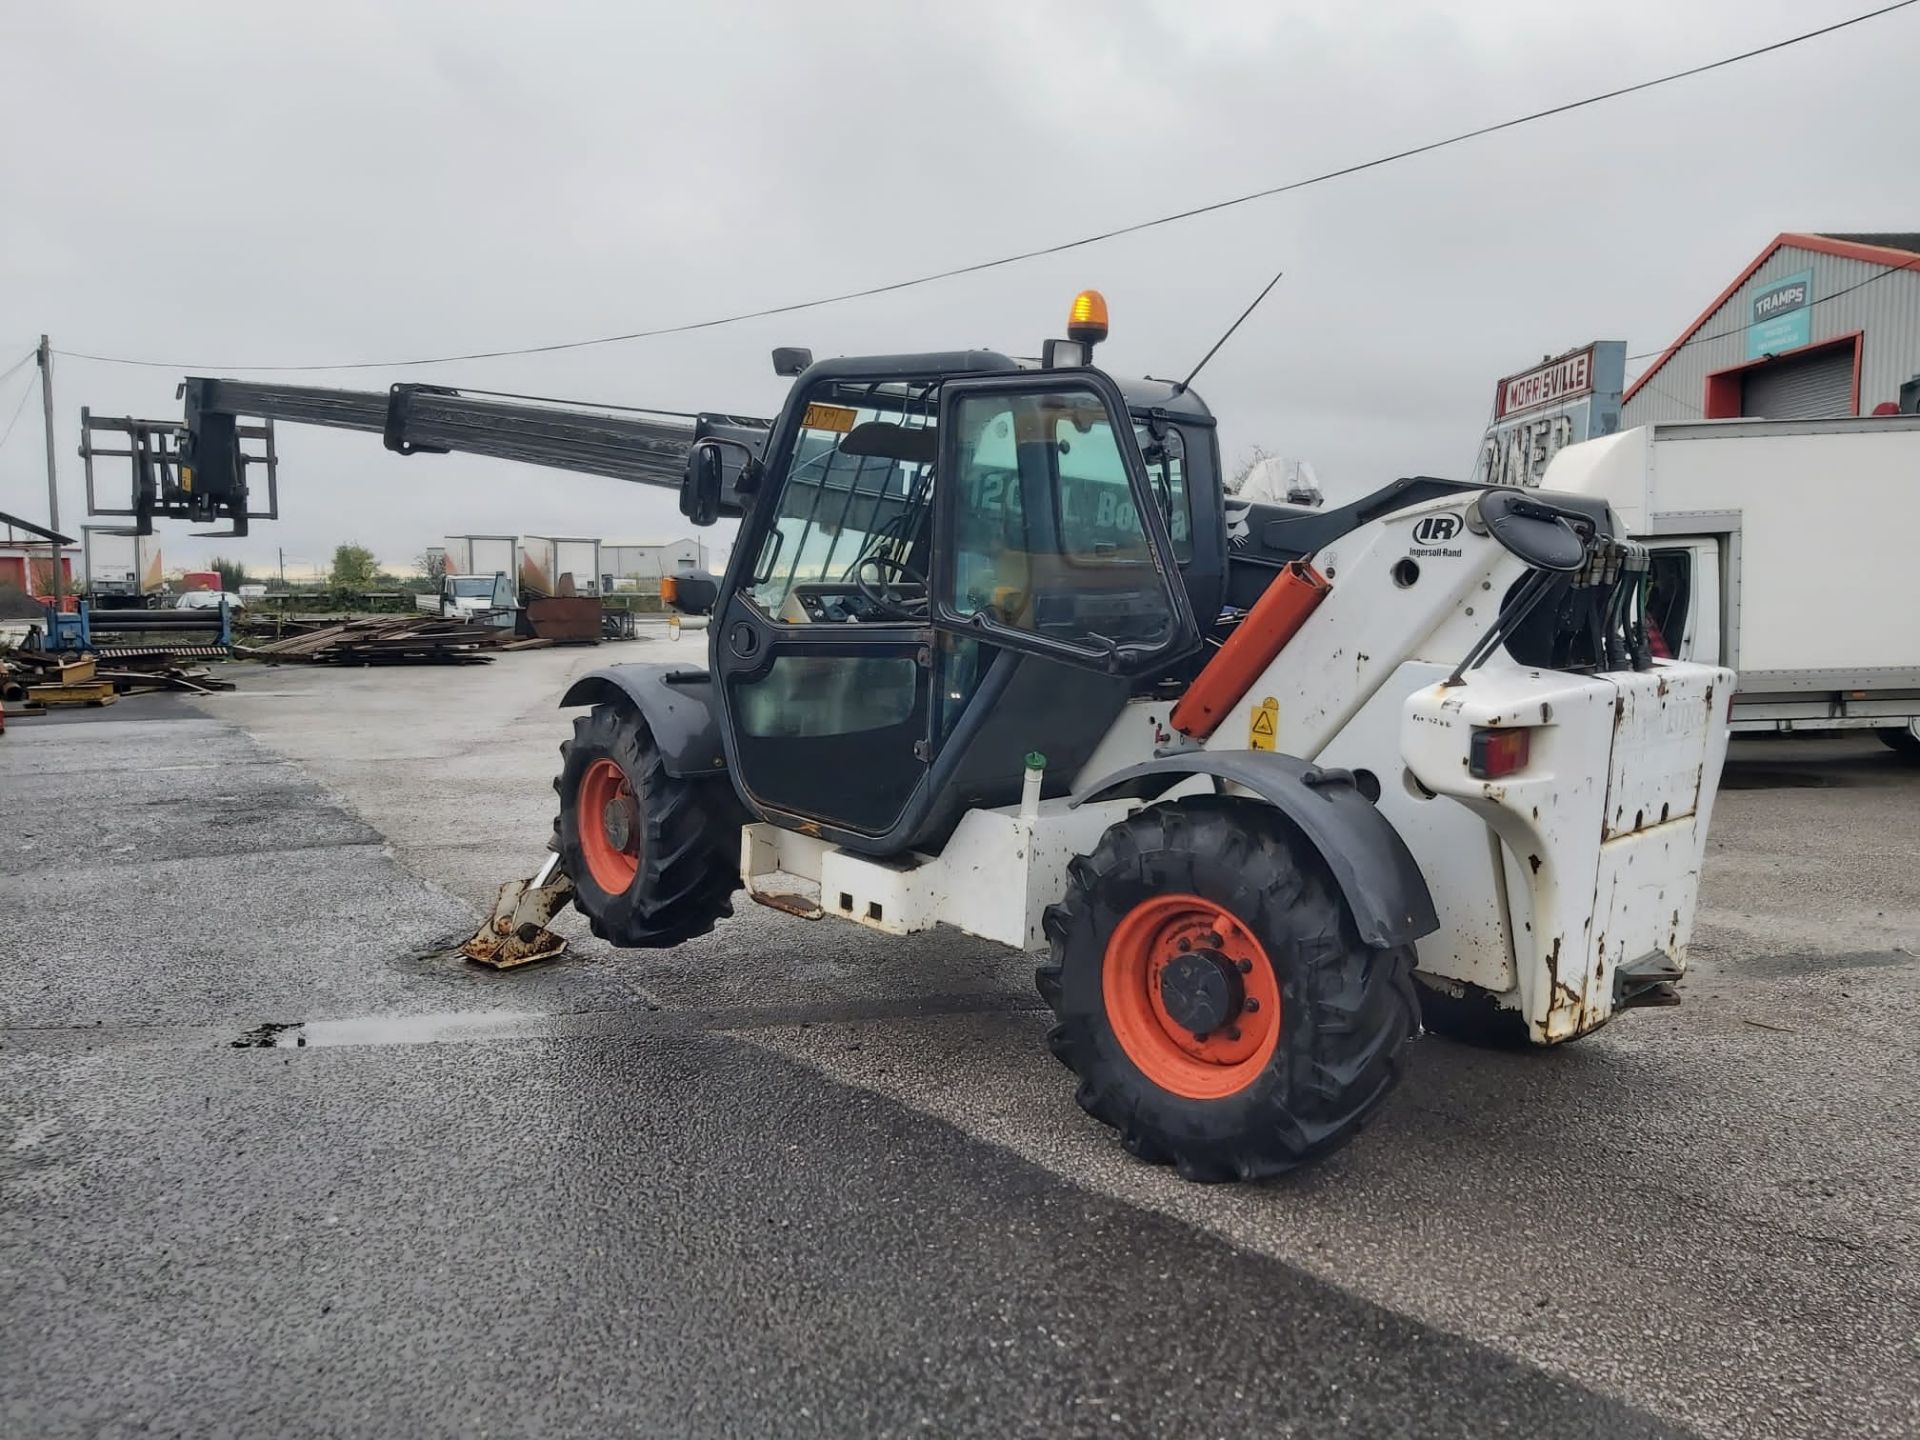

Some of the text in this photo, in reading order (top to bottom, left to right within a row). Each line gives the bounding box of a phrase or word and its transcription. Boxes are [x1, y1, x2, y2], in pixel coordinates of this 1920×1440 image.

[1755, 287, 1804, 315] TRAMPS
[1510, 359, 1585, 408] MORRISVILLE
[1420, 518, 1455, 540] IR
